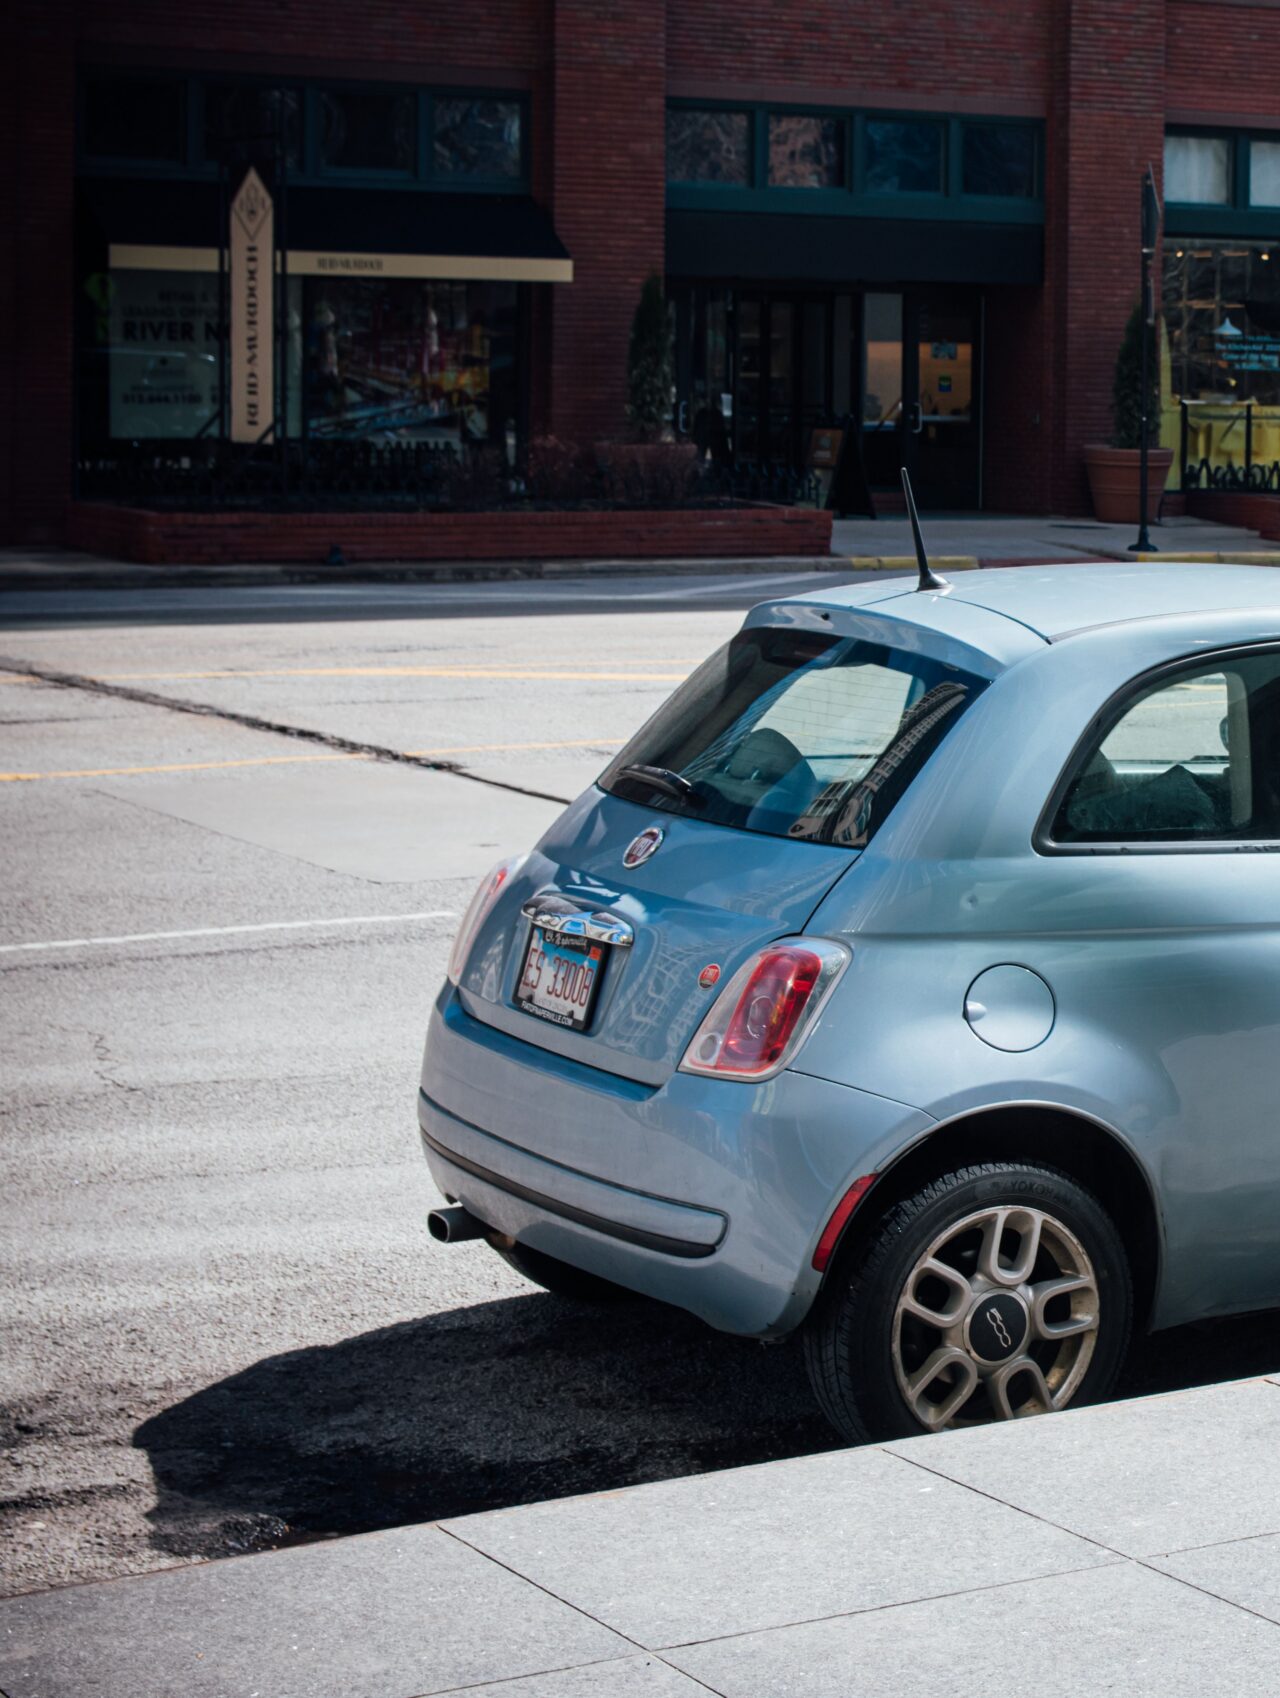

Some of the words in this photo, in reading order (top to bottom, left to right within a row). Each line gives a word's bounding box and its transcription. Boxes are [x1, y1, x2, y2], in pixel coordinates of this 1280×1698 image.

[123, 320, 196, 342] RIVER
[522, 948, 546, 988] ES
[547, 957, 594, 1007] 33008
